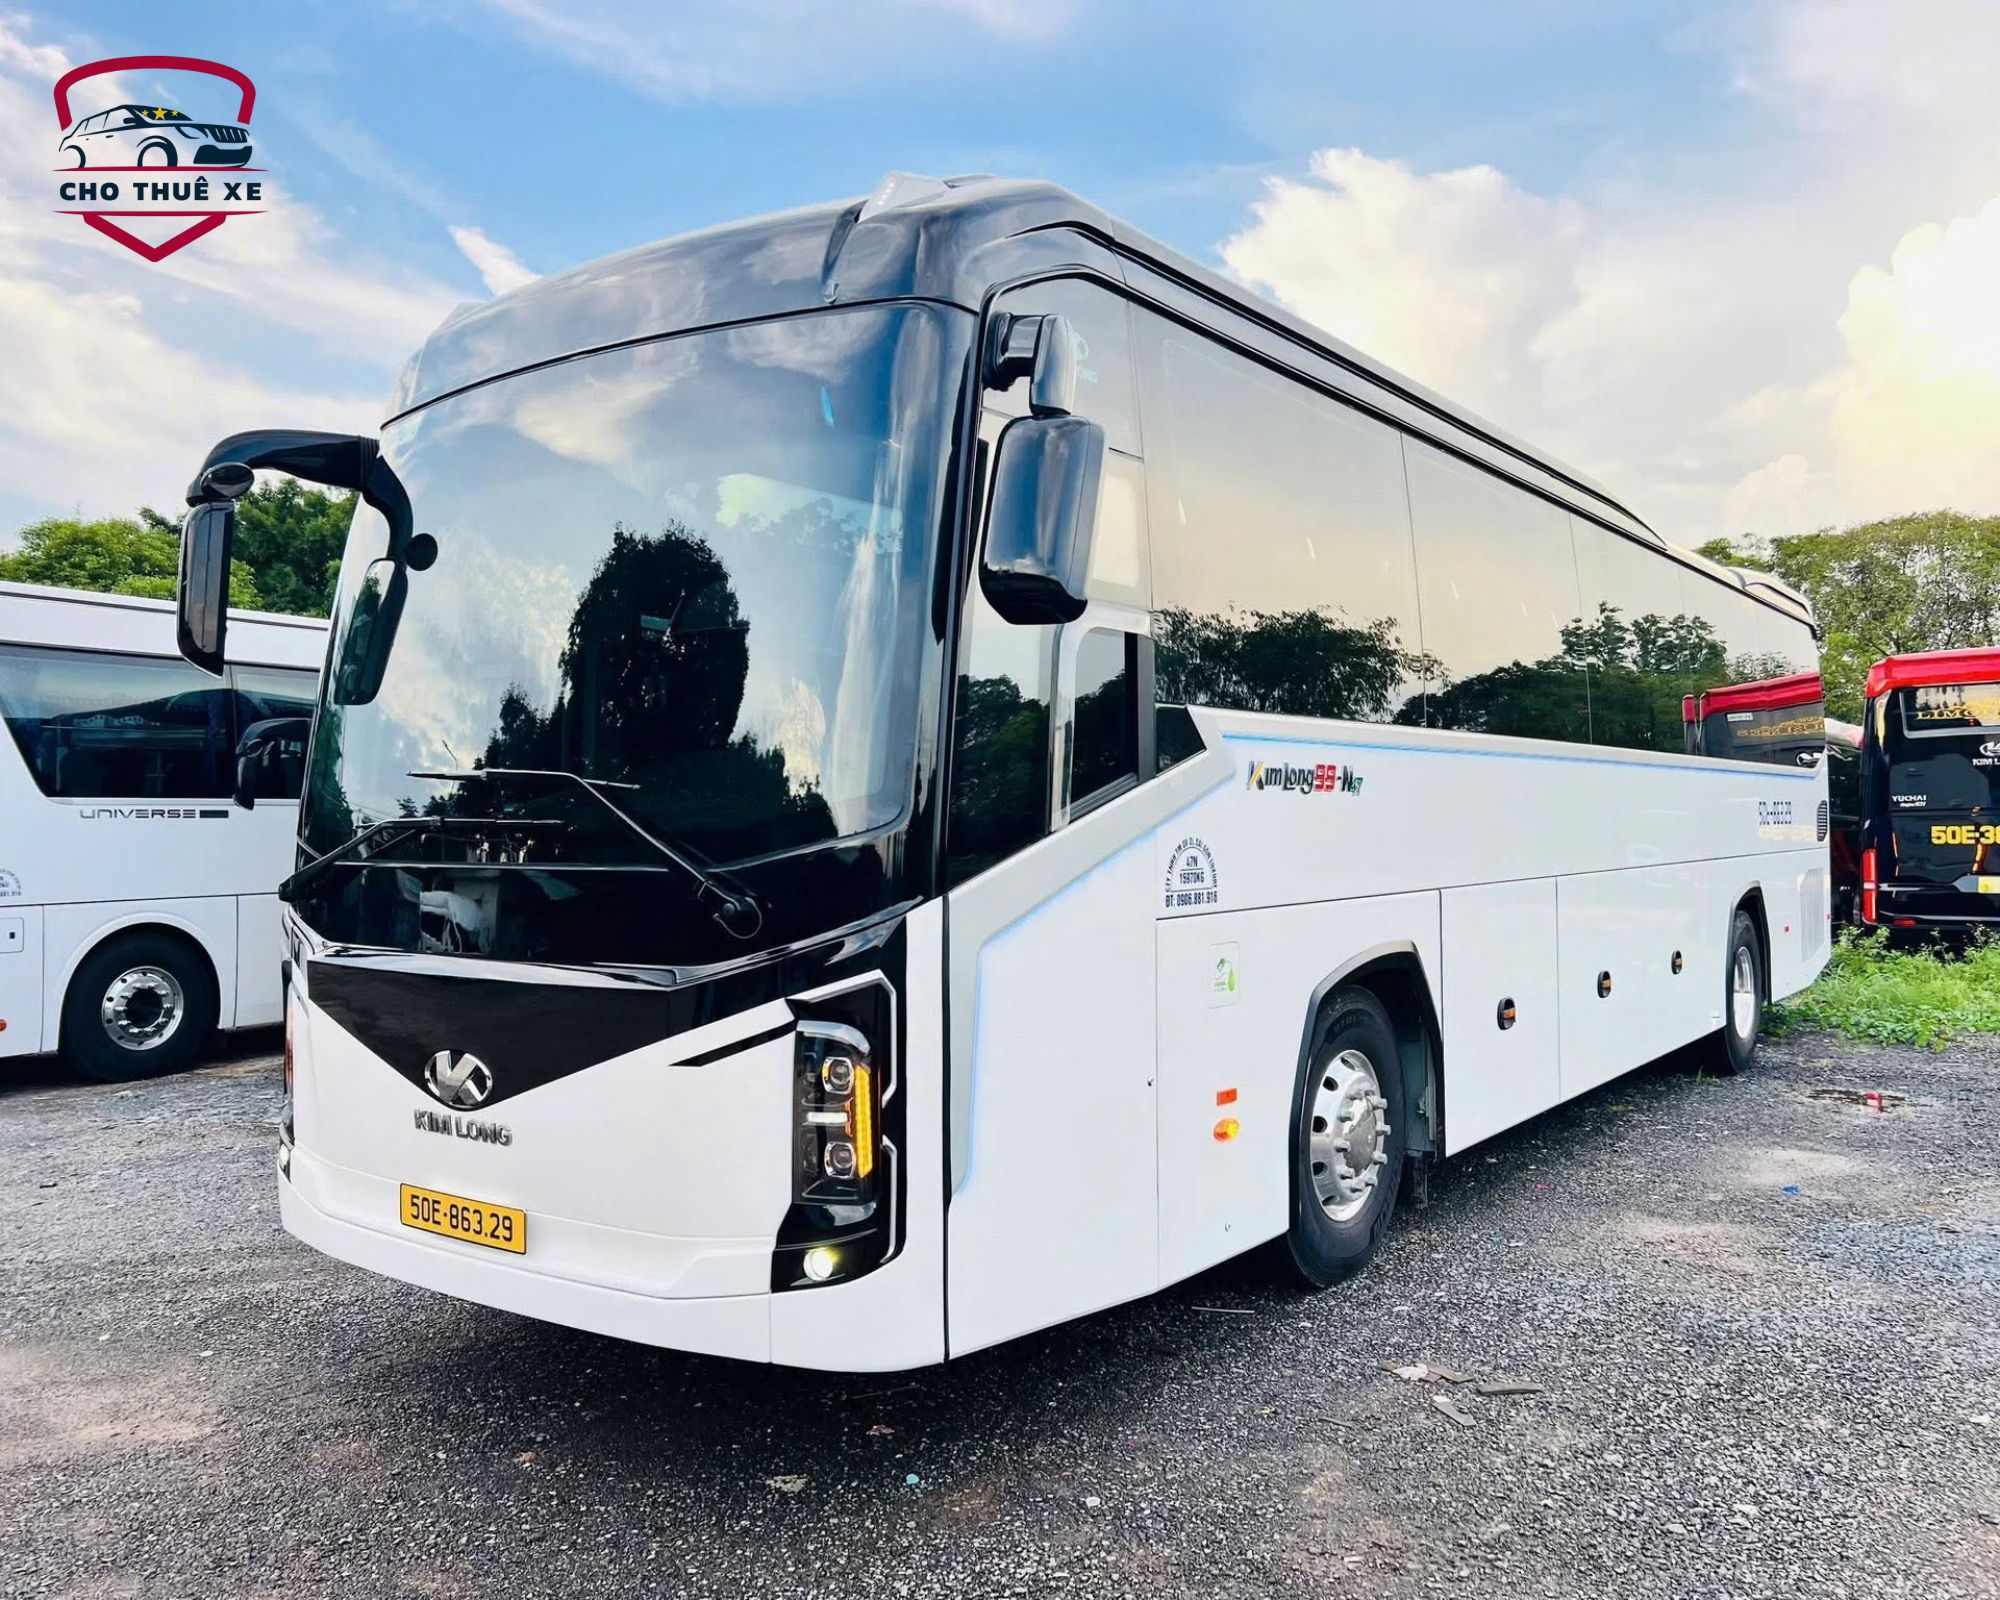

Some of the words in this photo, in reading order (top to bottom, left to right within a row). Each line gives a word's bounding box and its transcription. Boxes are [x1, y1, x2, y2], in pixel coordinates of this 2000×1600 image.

[80, 809, 196, 819] UNIVERSE
[414, 1109, 452, 1136] KIM
[455, 1117, 512, 1146] LONG
[410, 1194, 513, 1242] 50E-863.29
